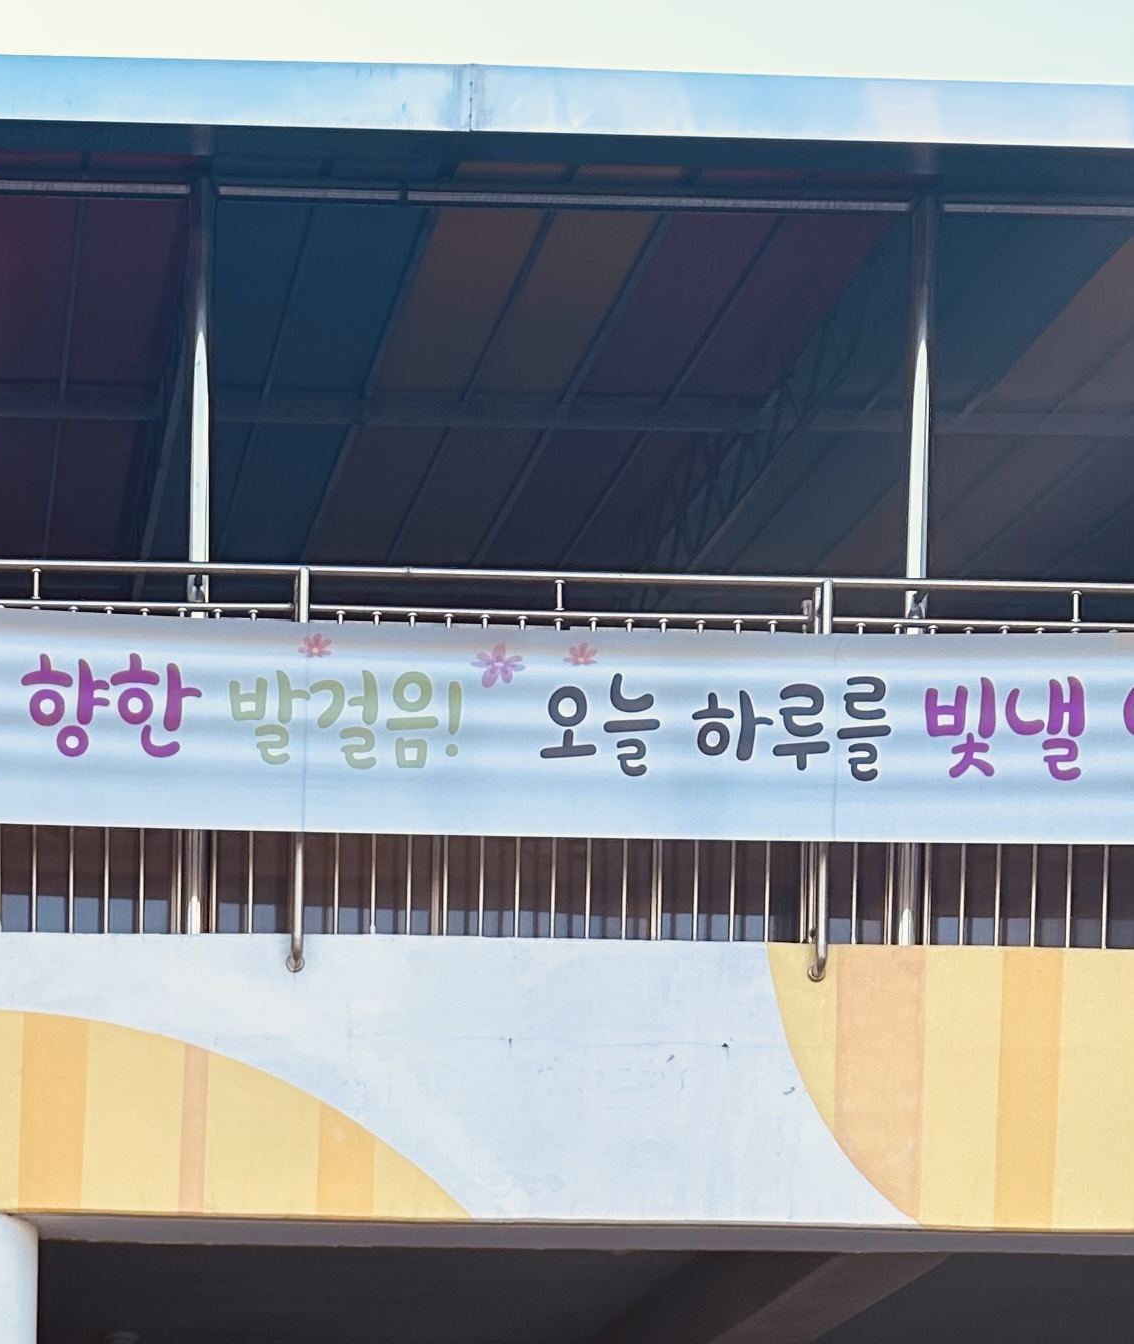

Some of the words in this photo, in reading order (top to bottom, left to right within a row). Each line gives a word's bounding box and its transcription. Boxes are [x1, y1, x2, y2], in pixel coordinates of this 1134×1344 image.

[20, 653, 202, 759] 향한
[229, 669, 462, 769] 발걸음!
[540, 673, 661, 777] 오늘
[691, 676, 893, 782] 하루를
[924, 676, 1086, 781] 빛낼
